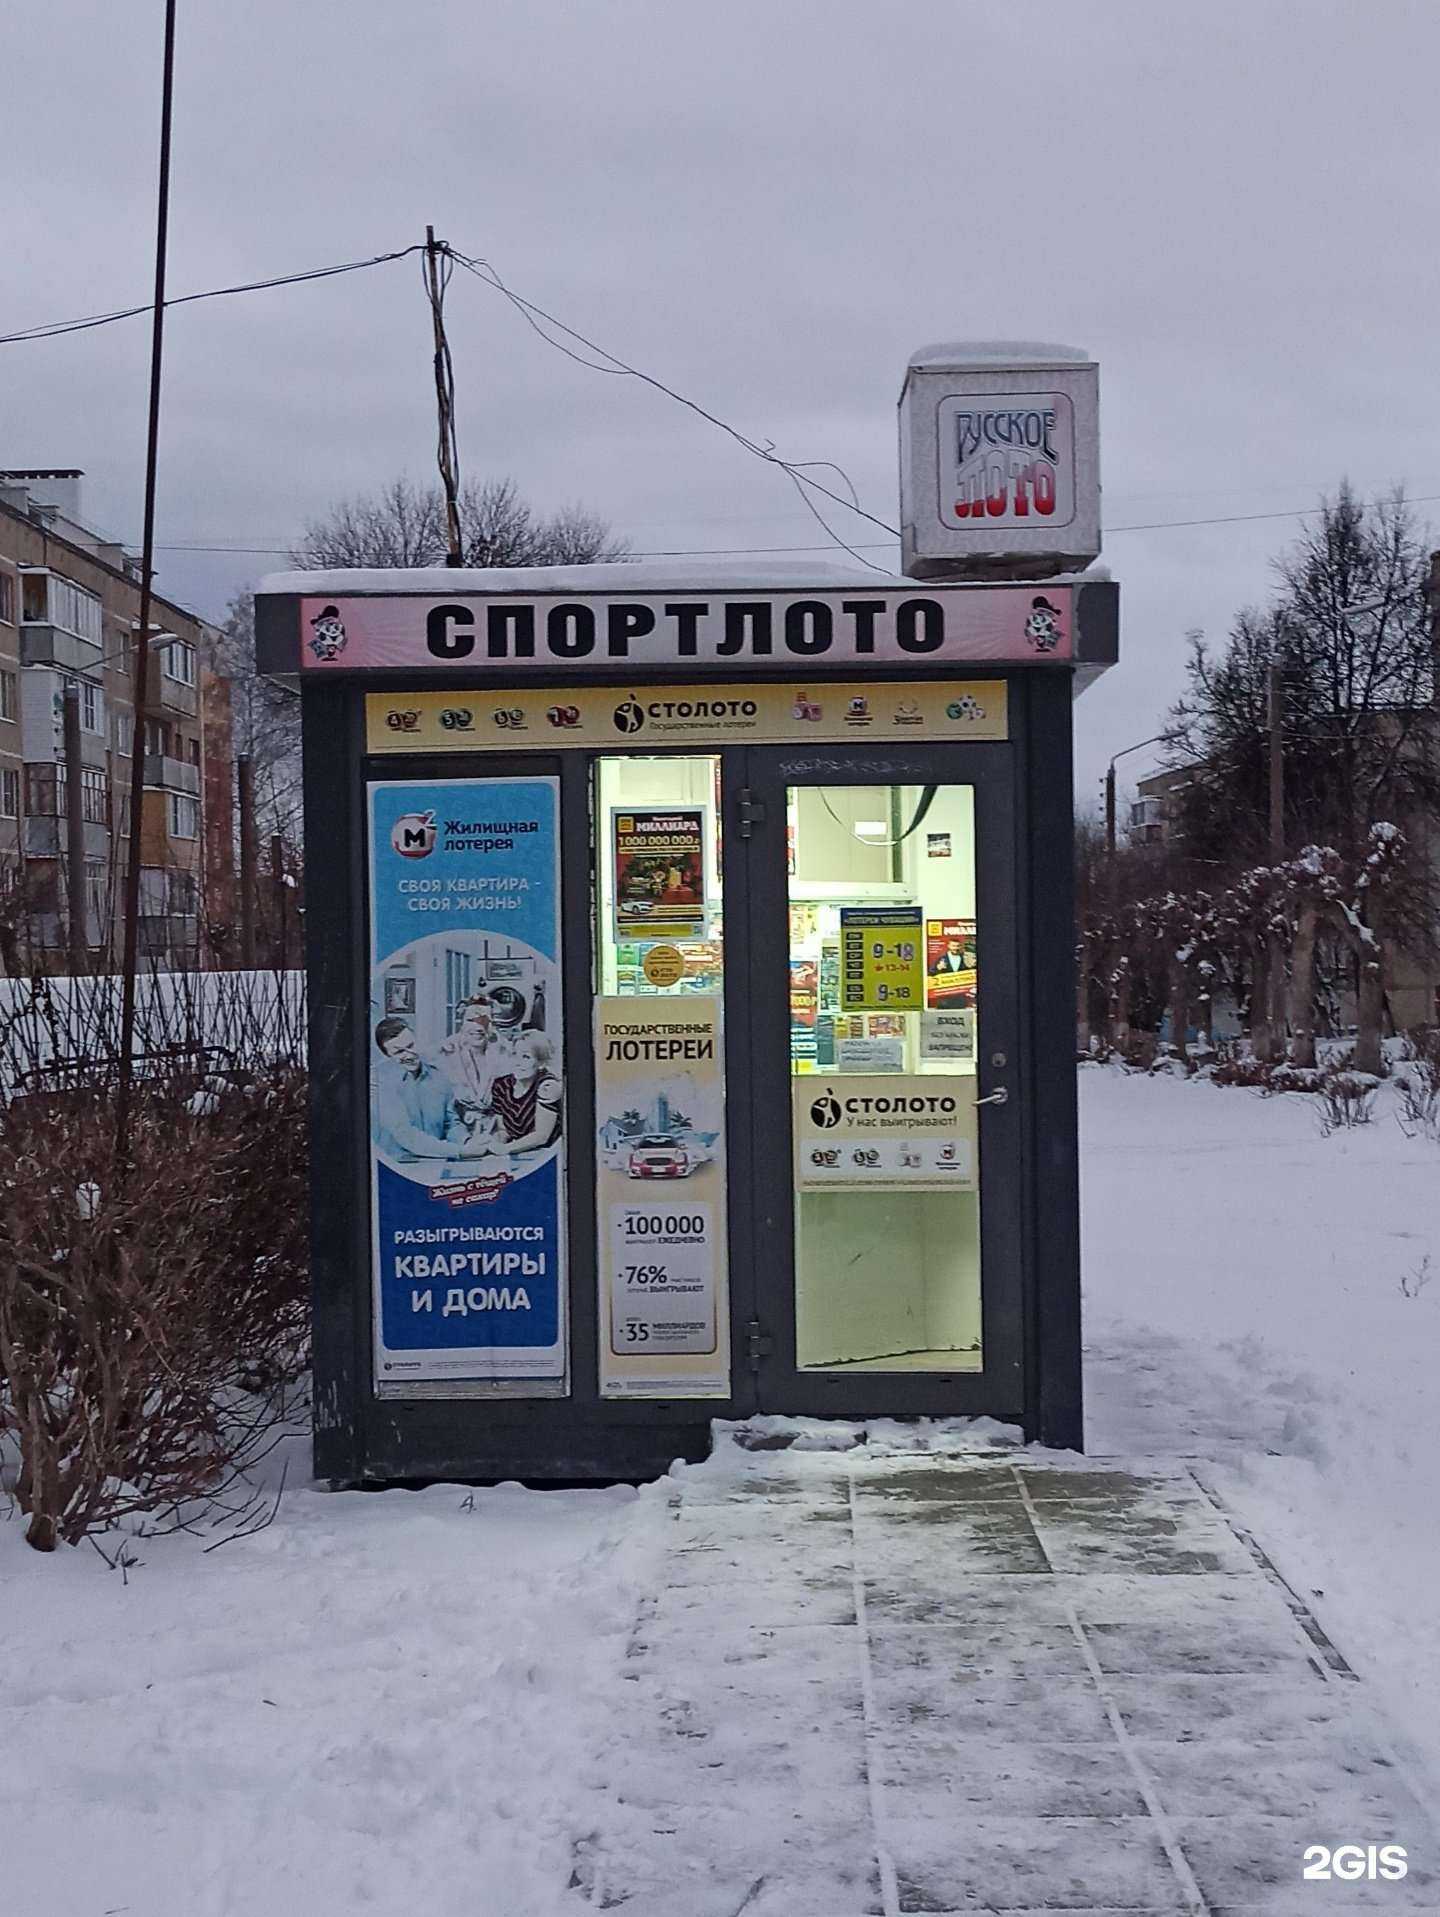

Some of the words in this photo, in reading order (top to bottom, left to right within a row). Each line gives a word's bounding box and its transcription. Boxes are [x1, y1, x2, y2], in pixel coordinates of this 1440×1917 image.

[955, 409, 1059, 465] РУССКОЕ
[955, 450, 1056, 518] ЛОТО
[426, 598, 945, 659] СПОРТЛОТО
[648, 700, 757, 718] СТОЛОТО
[443, 820, 539, 835] Жилищная
[444, 838, 513, 853] лотерея
[398, 880, 442, 893] СВОЯ
[448, 877, 529, 892] КВАРТИРА
[408, 898, 451, 911] СВОЯ
[456, 896, 521, 910] ЖИЗНЬ!
[604, 1023, 712, 1035] ГОСУДАРСТВЕННЫЕ
[606, 1039, 713, 1060] ЛОТЕРЕИ
[845, 1097, 956, 1113] СТОЛОТО
[857, 1118, 876, 1127] нас
[880, 1116, 957, 1129] выигрывают!
[394, 1227, 543, 1244] РАЗЫГРЫВАЮТСЯ
[395, 1253, 546, 1278] КВАРТИРЫ
[625, 1266, 667, 1284] 76%
[412, 1290, 433, 1312] И
[442, 1288, 531, 1317] ДОМА
[626, 1323, 649, 1341] 35
